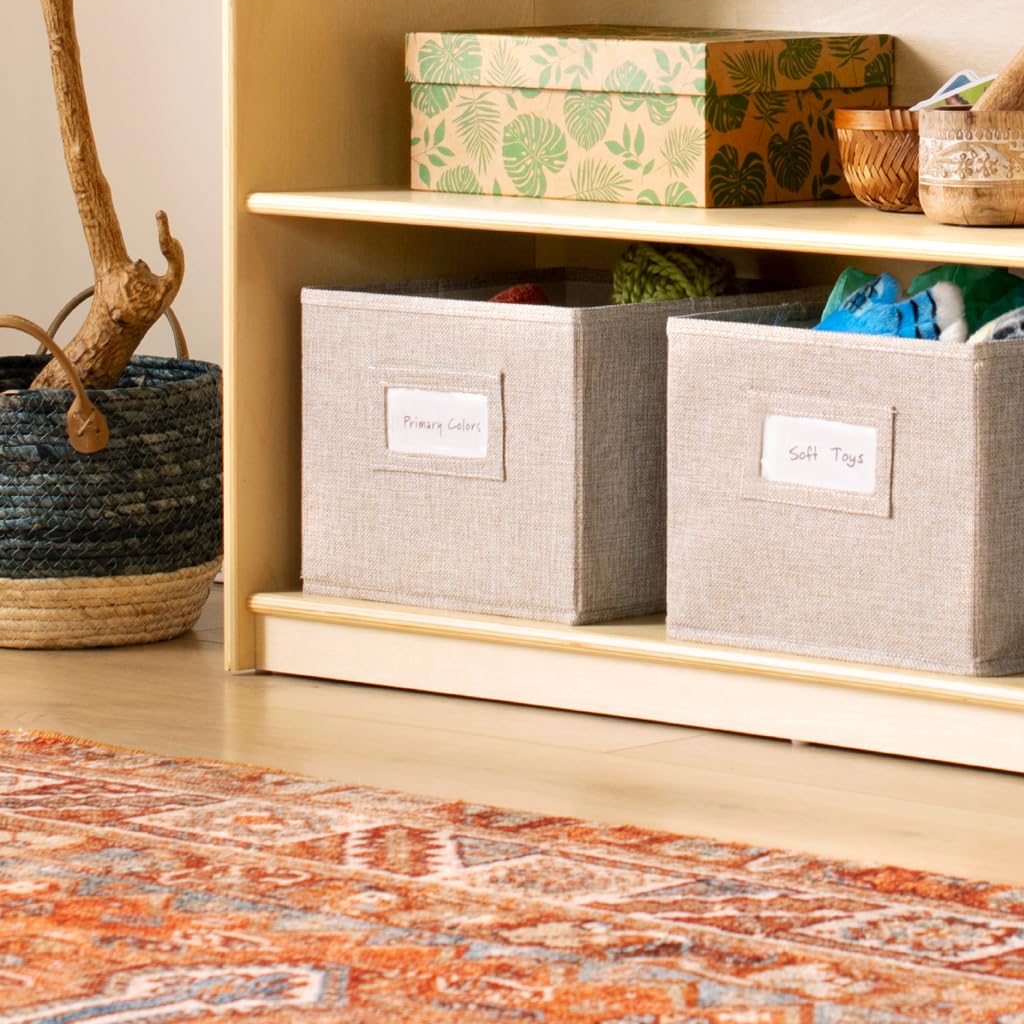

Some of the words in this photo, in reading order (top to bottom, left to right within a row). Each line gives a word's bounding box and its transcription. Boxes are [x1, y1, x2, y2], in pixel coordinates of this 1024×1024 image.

[403, 415, 442, 437] Primary
[447, 418, 481, 432] Colors
[788, 445, 818, 461] Soft
[831, 447, 864, 468] Toys
